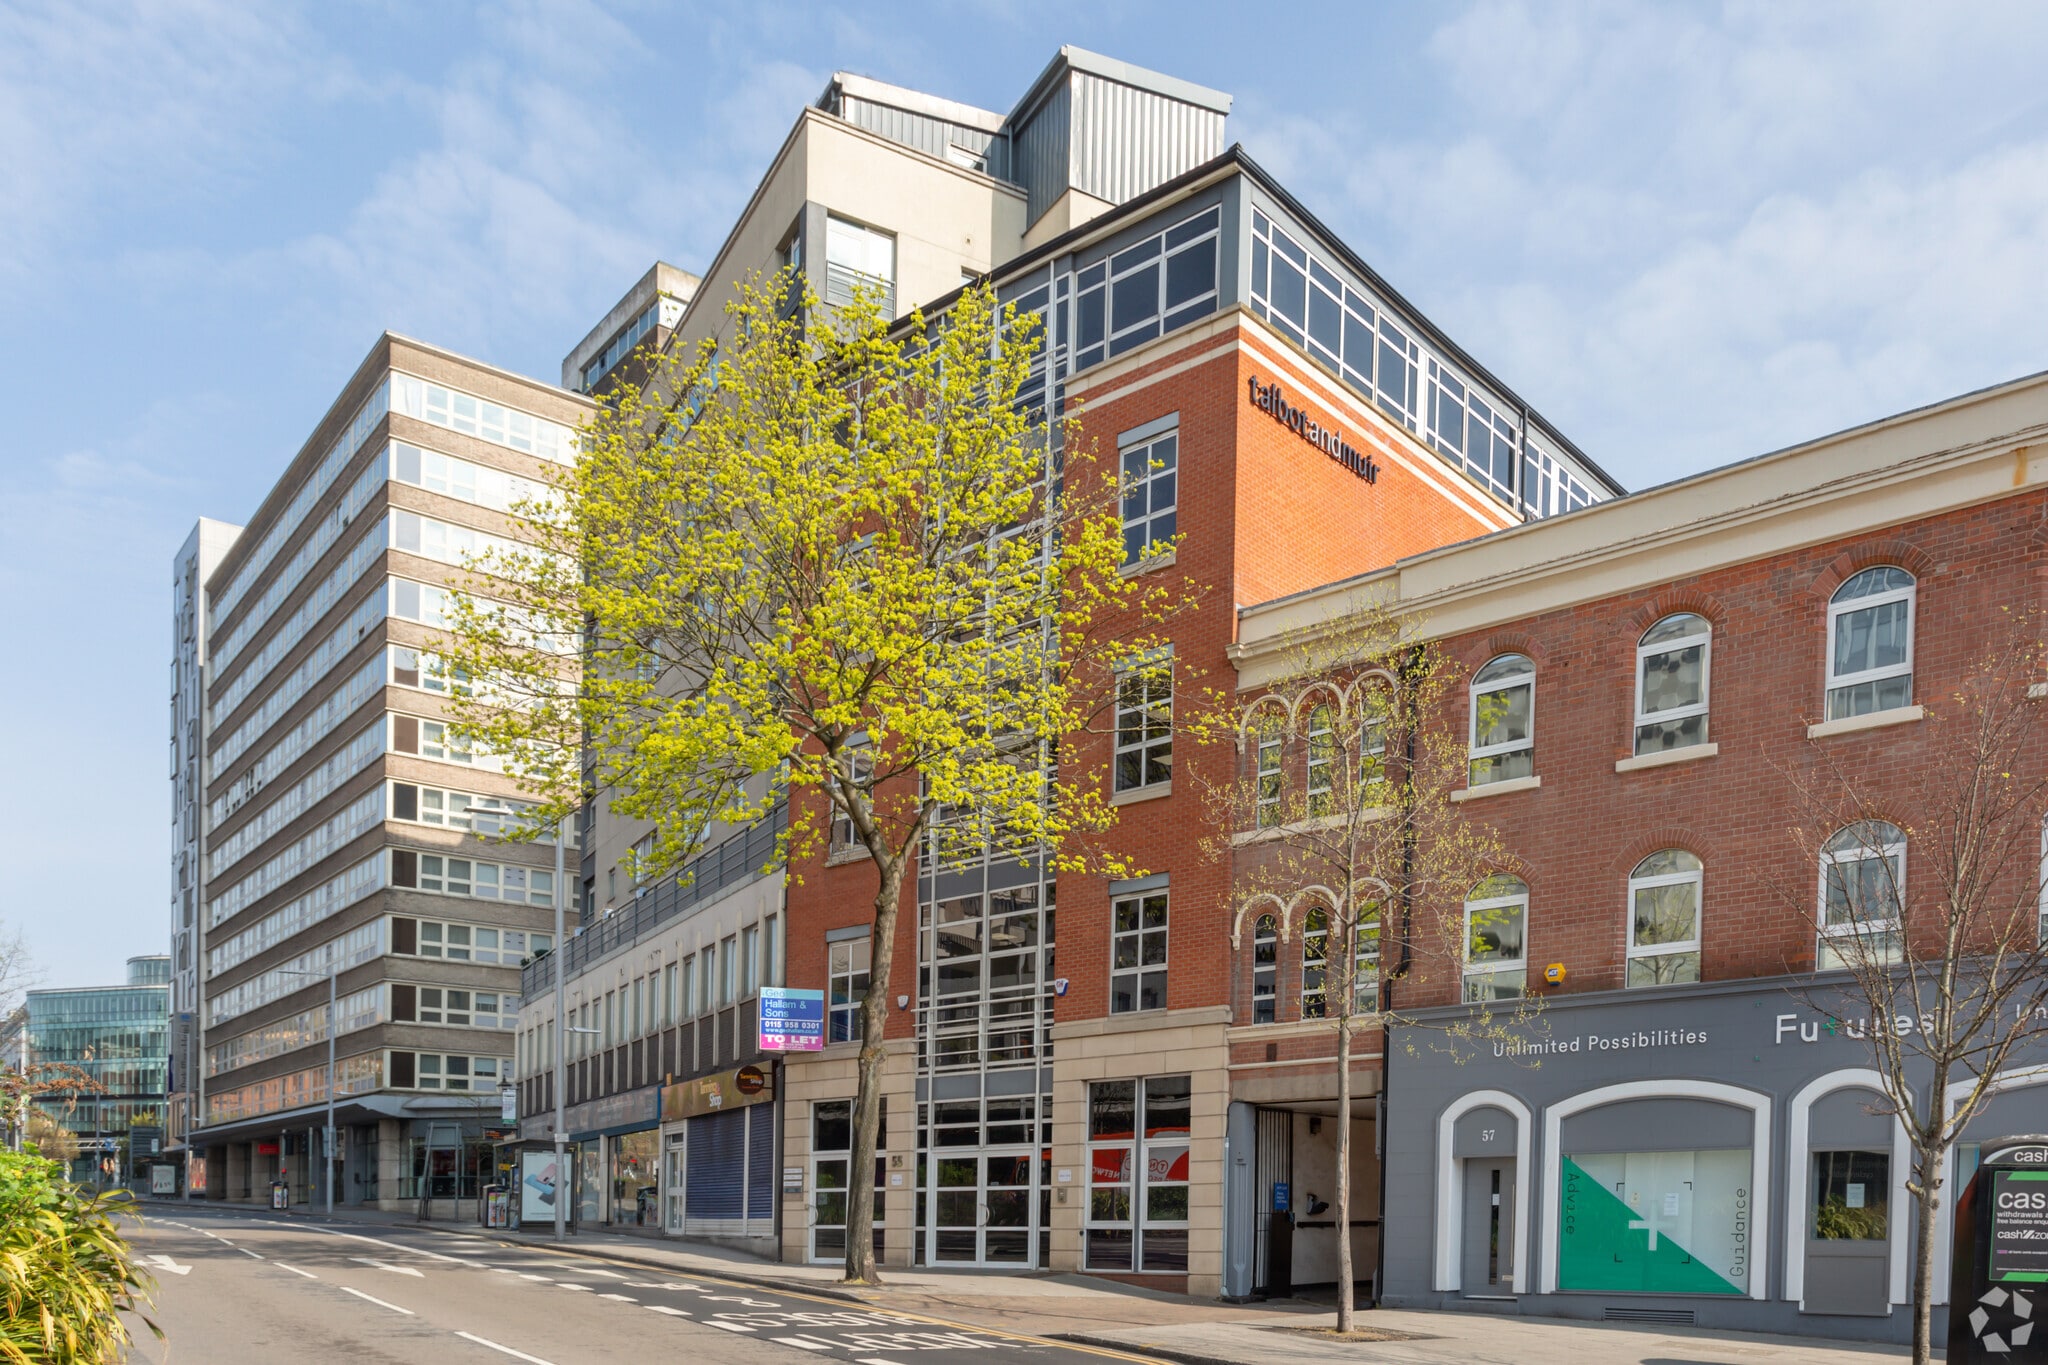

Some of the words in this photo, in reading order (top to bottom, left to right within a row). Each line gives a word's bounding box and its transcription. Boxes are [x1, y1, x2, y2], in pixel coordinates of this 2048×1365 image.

[1249, 375, 1380, 484] talbotandmuir
[765, 989, 786, 997] Geo
[765, 999, 796, 1009] Hallam
[799, 1000, 807, 1009] &
[765, 1008, 789, 1018] Sons
[764, 1034, 786, 1043] TO
[791, 1035, 818, 1044] LET
[1493, 1037, 1579, 1057] Unlimited
[1588, 1029, 1708, 1052] Possibilities
[1482, 1129, 1496, 1142] 57
[1565, 1172, 1580, 1235] Advice
[1998, 1192, 2048, 1209] cas
[1729, 1187, 1746, 1277] Guidance
